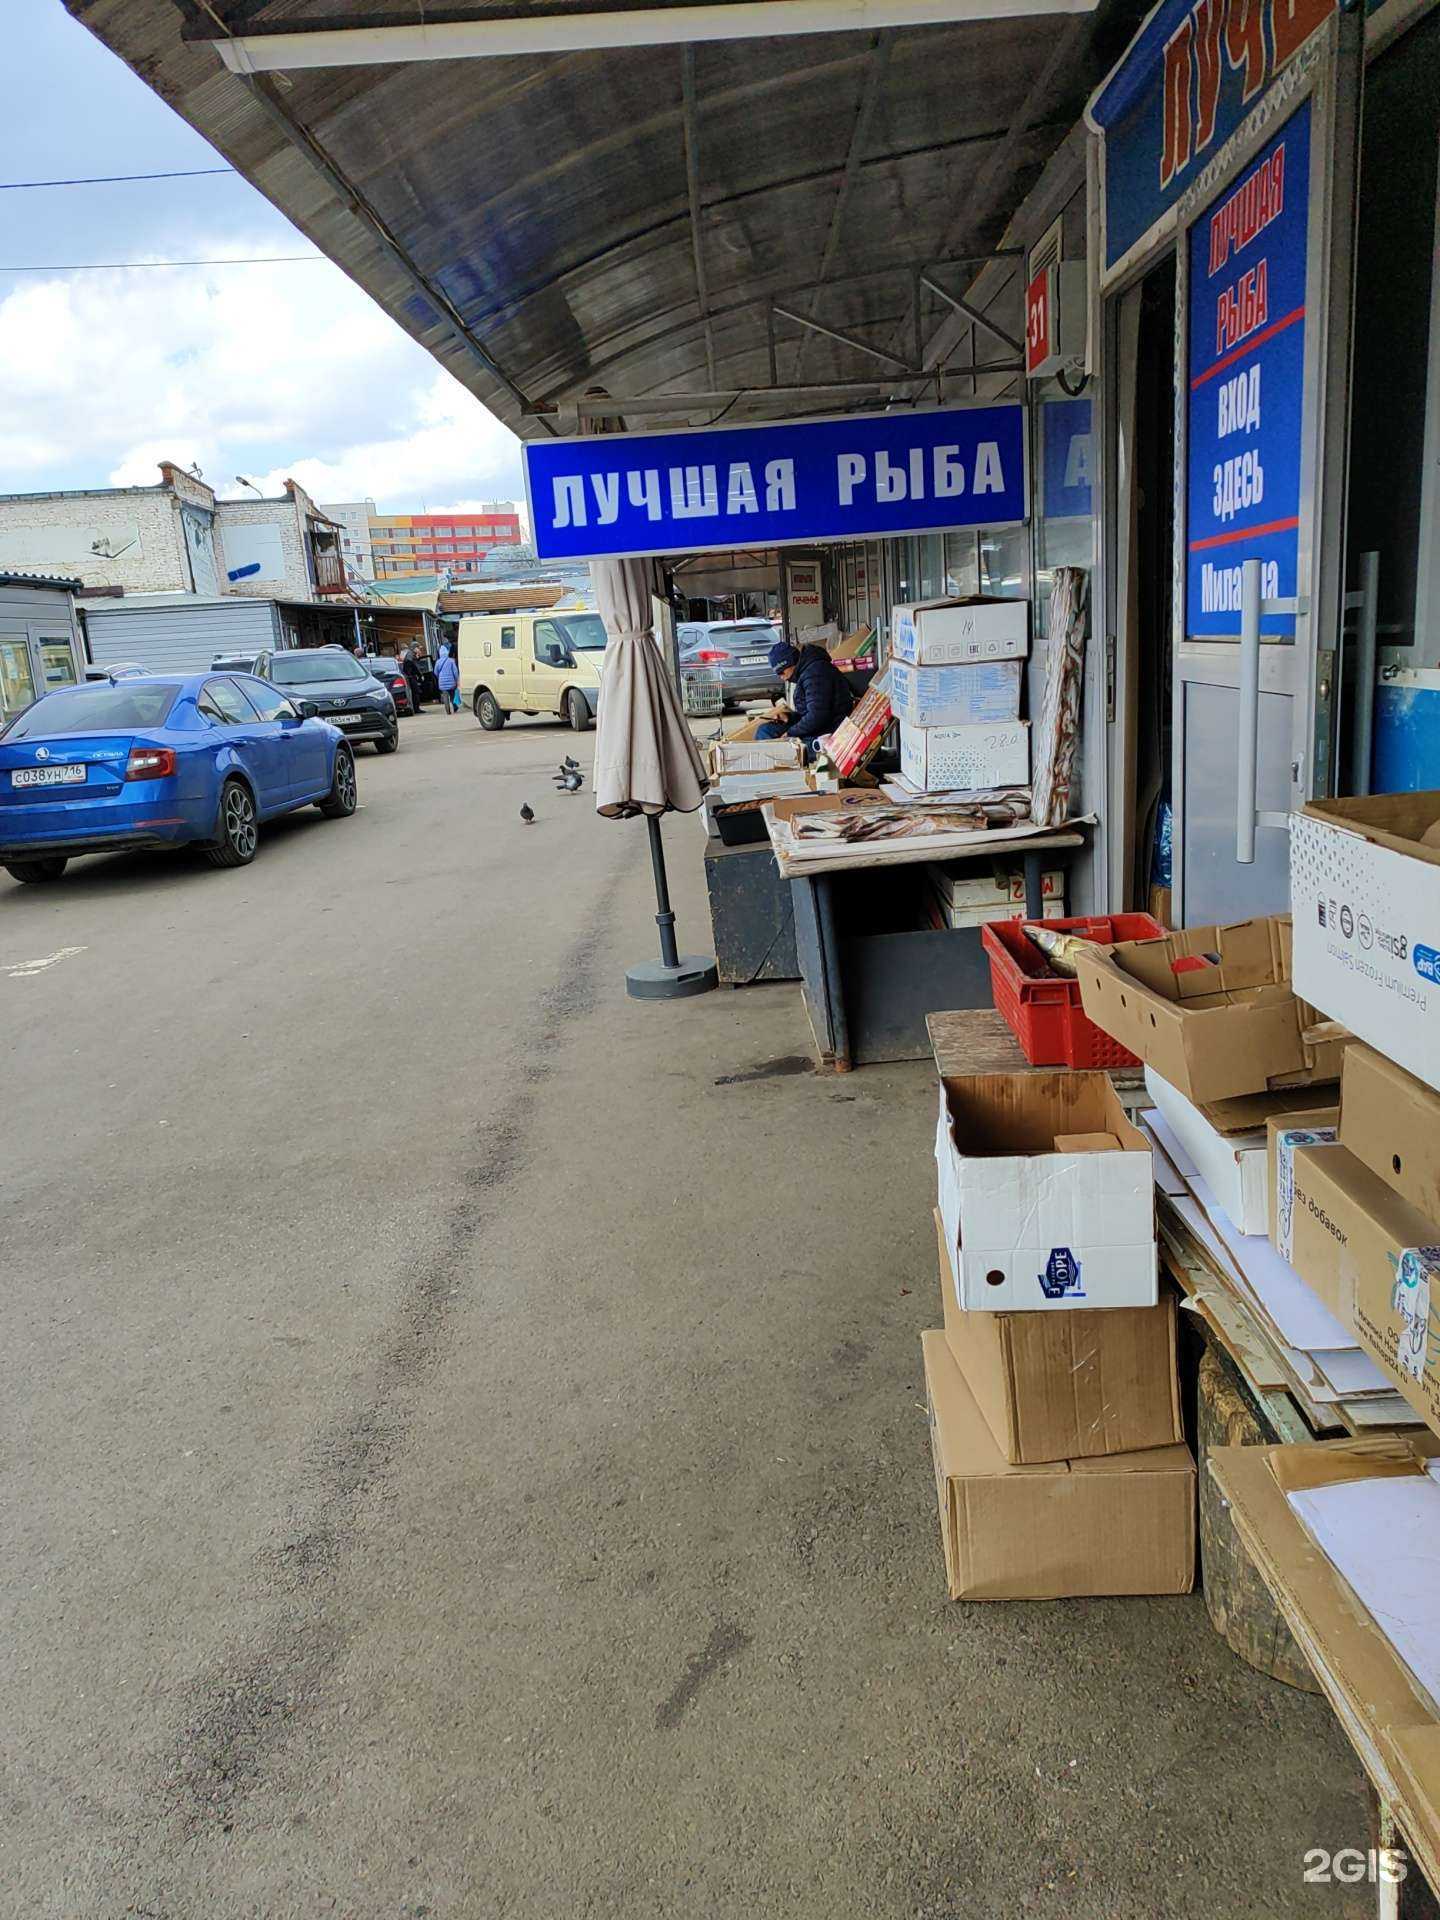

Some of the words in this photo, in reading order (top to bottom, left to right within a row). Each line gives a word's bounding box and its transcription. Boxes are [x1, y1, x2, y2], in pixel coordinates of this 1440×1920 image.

[1208, 142, 1285, 278] ЛУЧШАЯ
[1031, 295, 1044, 348] 31
[1216, 258, 1268, 356] РЫБА
[1218, 363, 1261, 439] ВХОД
[551, 458, 796, 529] ЛУЧШАЯ
[836, 441, 1005, 506] РЫБА
[1213, 449, 1264, 523] ЗДЕСЬ
[1202, 560, 1279, 613] Милаа
[1385, 974, 1427, 1012] Premium
[1308, 1198, 1348, 1248] добавок
